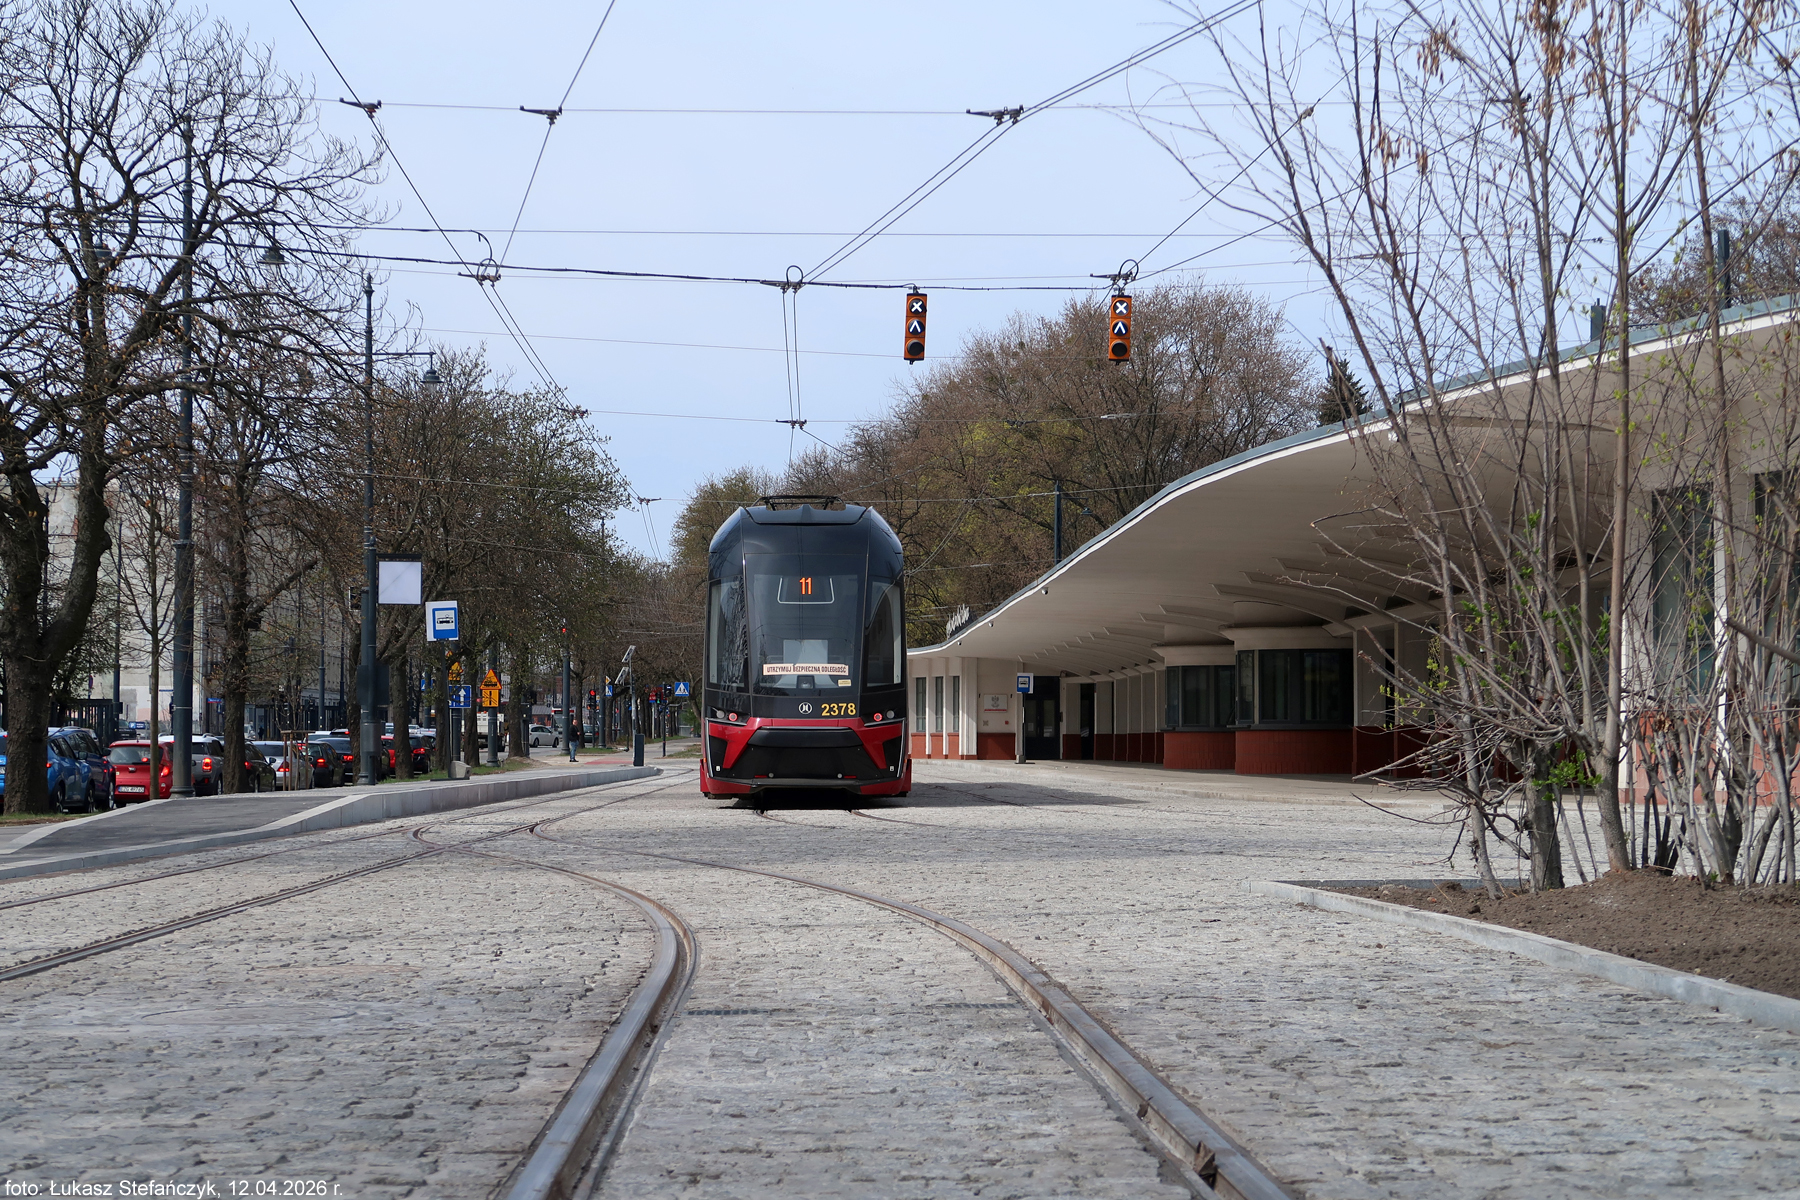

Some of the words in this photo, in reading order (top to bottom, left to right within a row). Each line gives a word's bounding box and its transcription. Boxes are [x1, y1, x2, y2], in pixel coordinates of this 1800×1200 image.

[799, 577, 813, 595] 11
[766, 665, 792, 673] UTRZYMUJ
[821, 702, 857, 716] 2378
